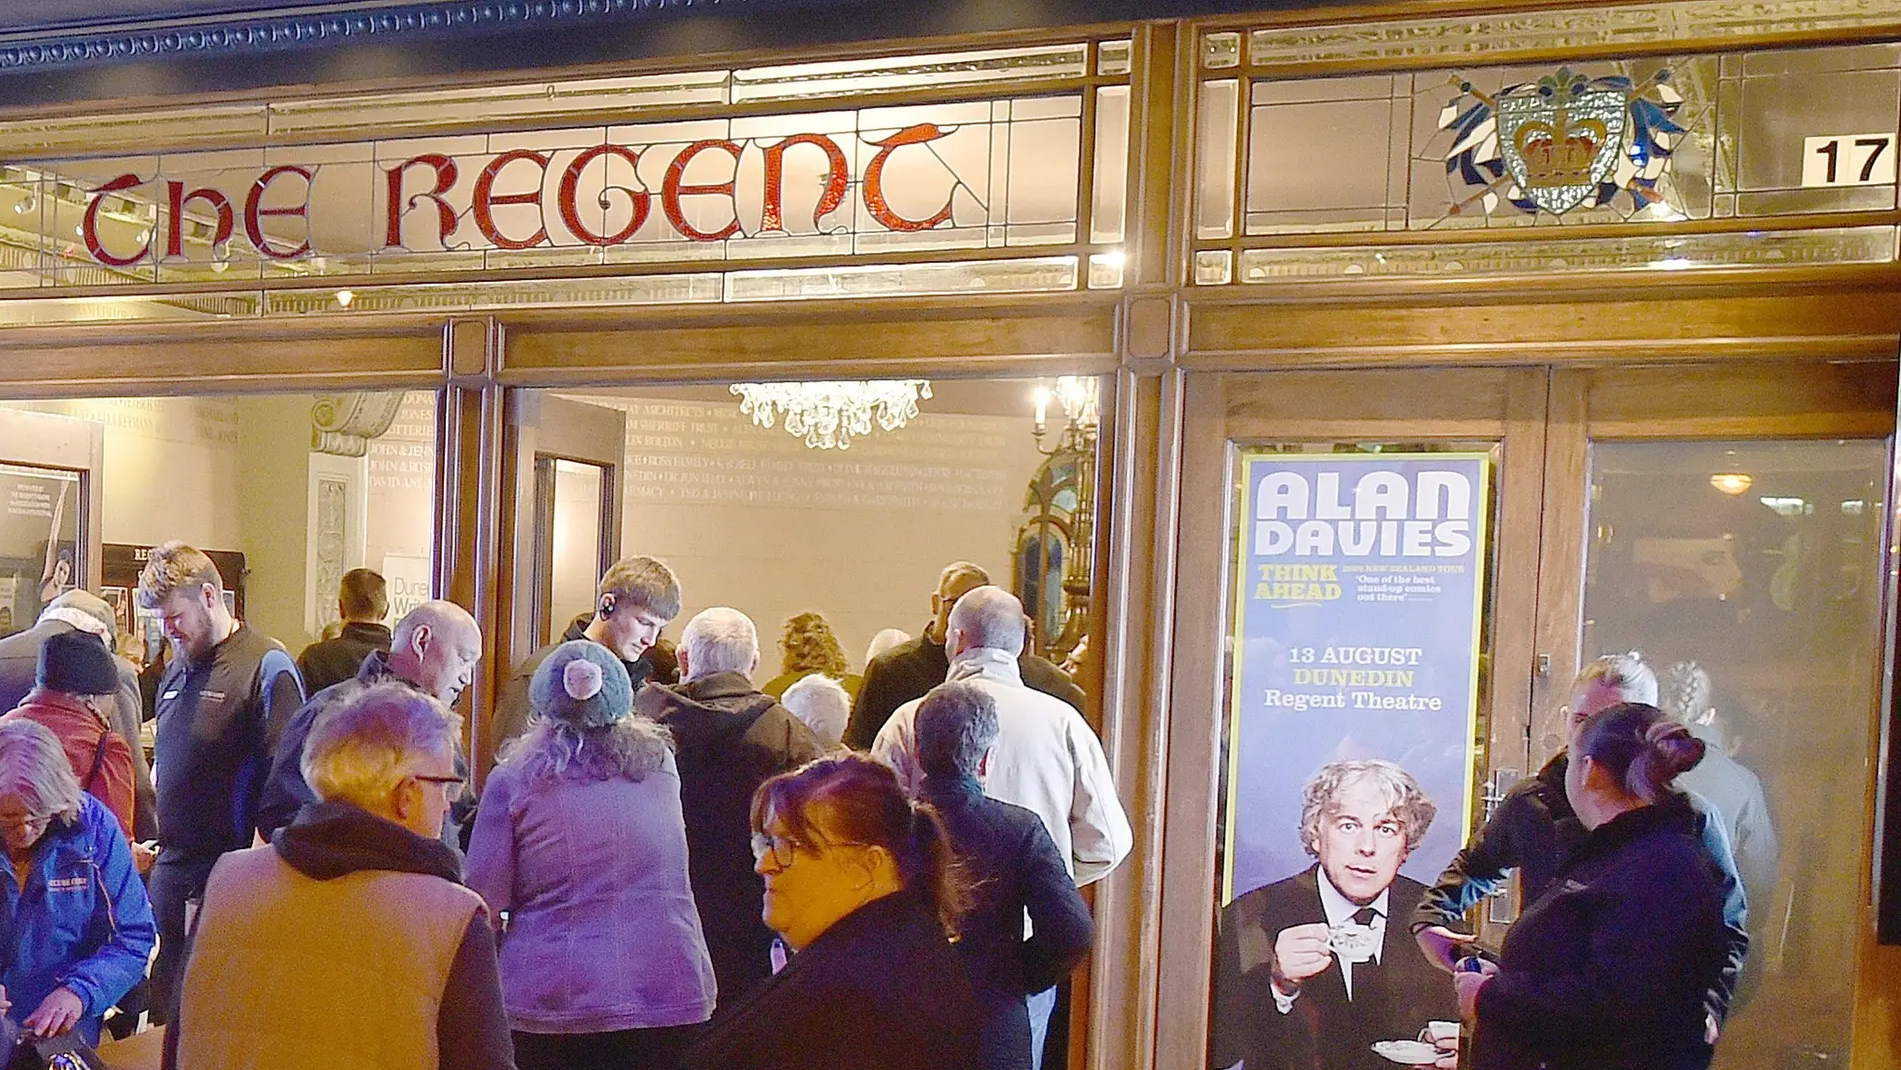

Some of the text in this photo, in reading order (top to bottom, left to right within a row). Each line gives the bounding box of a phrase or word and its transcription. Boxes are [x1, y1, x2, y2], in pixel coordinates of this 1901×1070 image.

[1816, 138, 1890, 183] 17
[83, 123, 960, 267] THE REGENT
[388, 424, 434, 437] OTTERIE
[1256, 471, 1472, 520] ALAN
[1254, 520, 1472, 557] DAVIES
[1258, 563, 1338, 582] THINK
[1381, 575, 1393, 584] of
[1393, 575, 1411, 584] the
[1412, 575, 1435, 584] best
[393, 576, 428, 597] Dune
[1254, 583, 1343, 601] AHEAD
[1357, 583, 1441, 594] stand-up comics
[1357, 593, 1375, 601] out
[1289, 647, 1423, 665] 13 AUGUST
[1293, 669, 1415, 687] DUNEDIN
[1264, 689, 1442, 712] Regent Theatre
